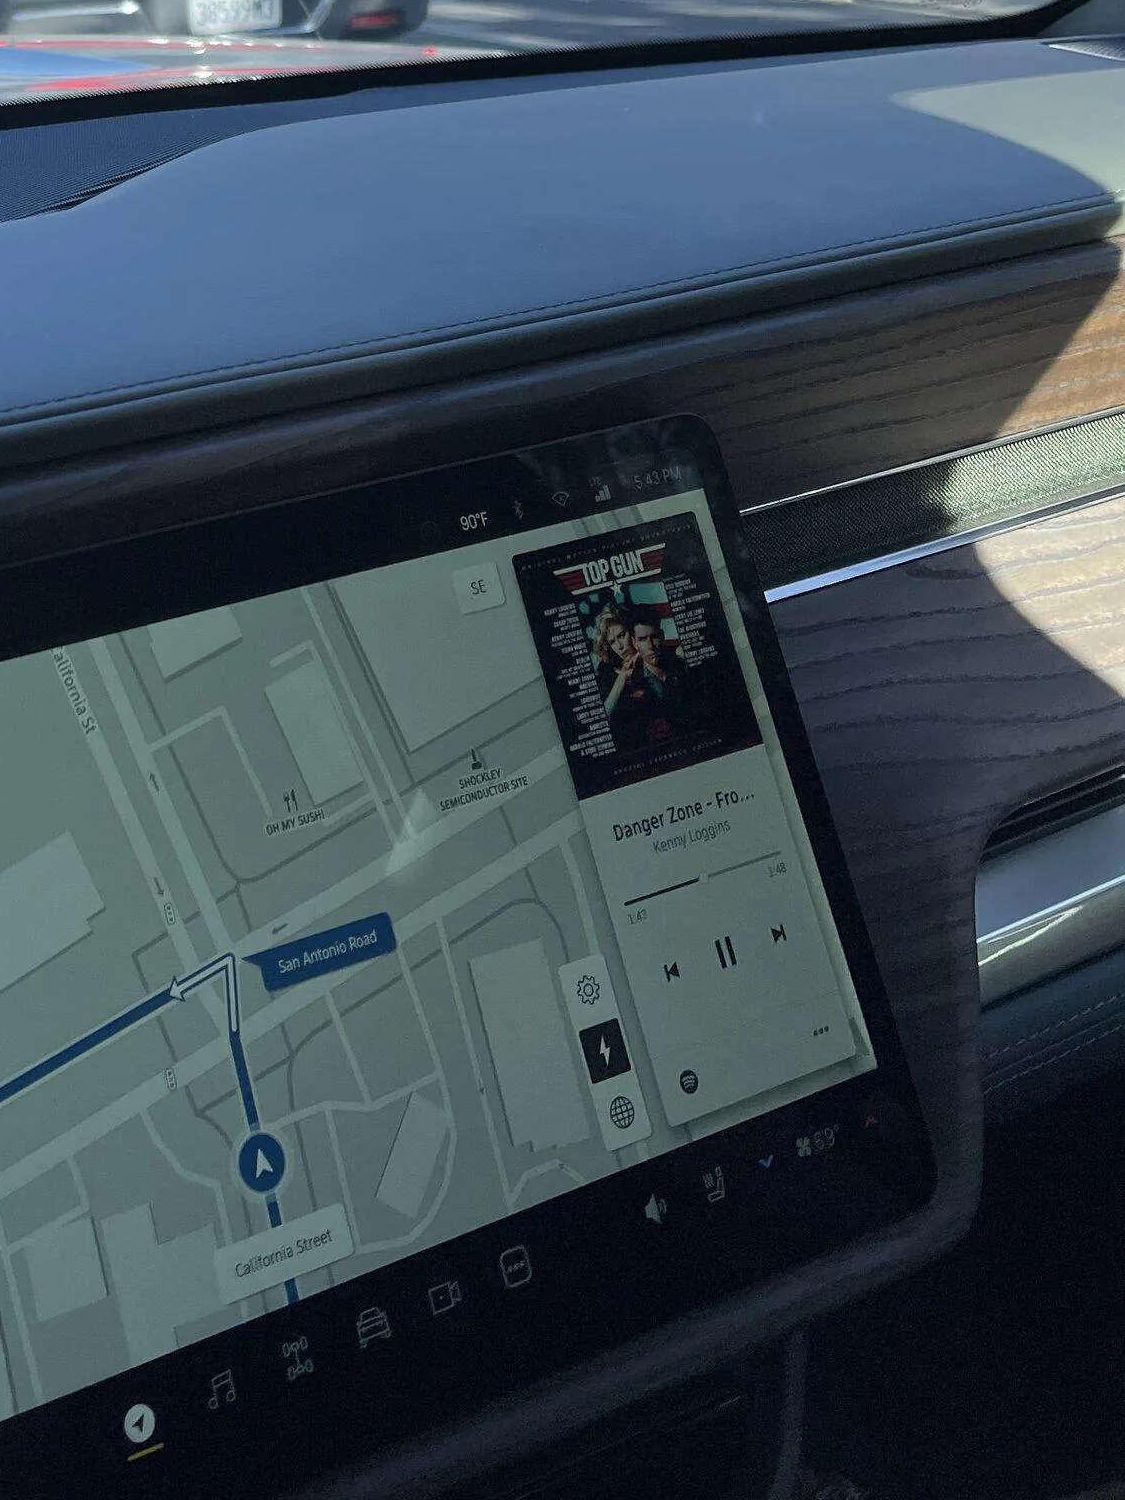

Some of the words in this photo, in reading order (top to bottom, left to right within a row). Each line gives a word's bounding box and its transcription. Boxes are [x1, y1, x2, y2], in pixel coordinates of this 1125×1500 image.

[662, 465, 683, 485] PM
[460, 510, 489, 532] 90°F
[580, 558, 611, 587] TOP
[610, 550, 646, 578] GUN
[470, 579, 488, 596] SE
[81, 716, 97, 736] St
[458, 767, 502, 789] SHOCKLEY
[439, 781, 510, 812] SEMICONDUCTOR
[510, 775, 529, 790] SITE
[266, 822, 280, 836] OH
[281, 817, 296, 831] MY
[297, 808, 325, 827] SUSHI
[612, 813, 665, 842] Danger
[666, 801, 704, 824] Zone
[652, 833, 687, 854] Kenny
[688, 819, 732, 843] Loggins
[767, 861, 788, 878] 1:48
[278, 958, 301, 974] San
[302, 941, 348, 967] Antonio
[347, 928, 379, 952] Road
[234, 1244, 295, 1278] California
[295, 1228, 334, 1255] Street
